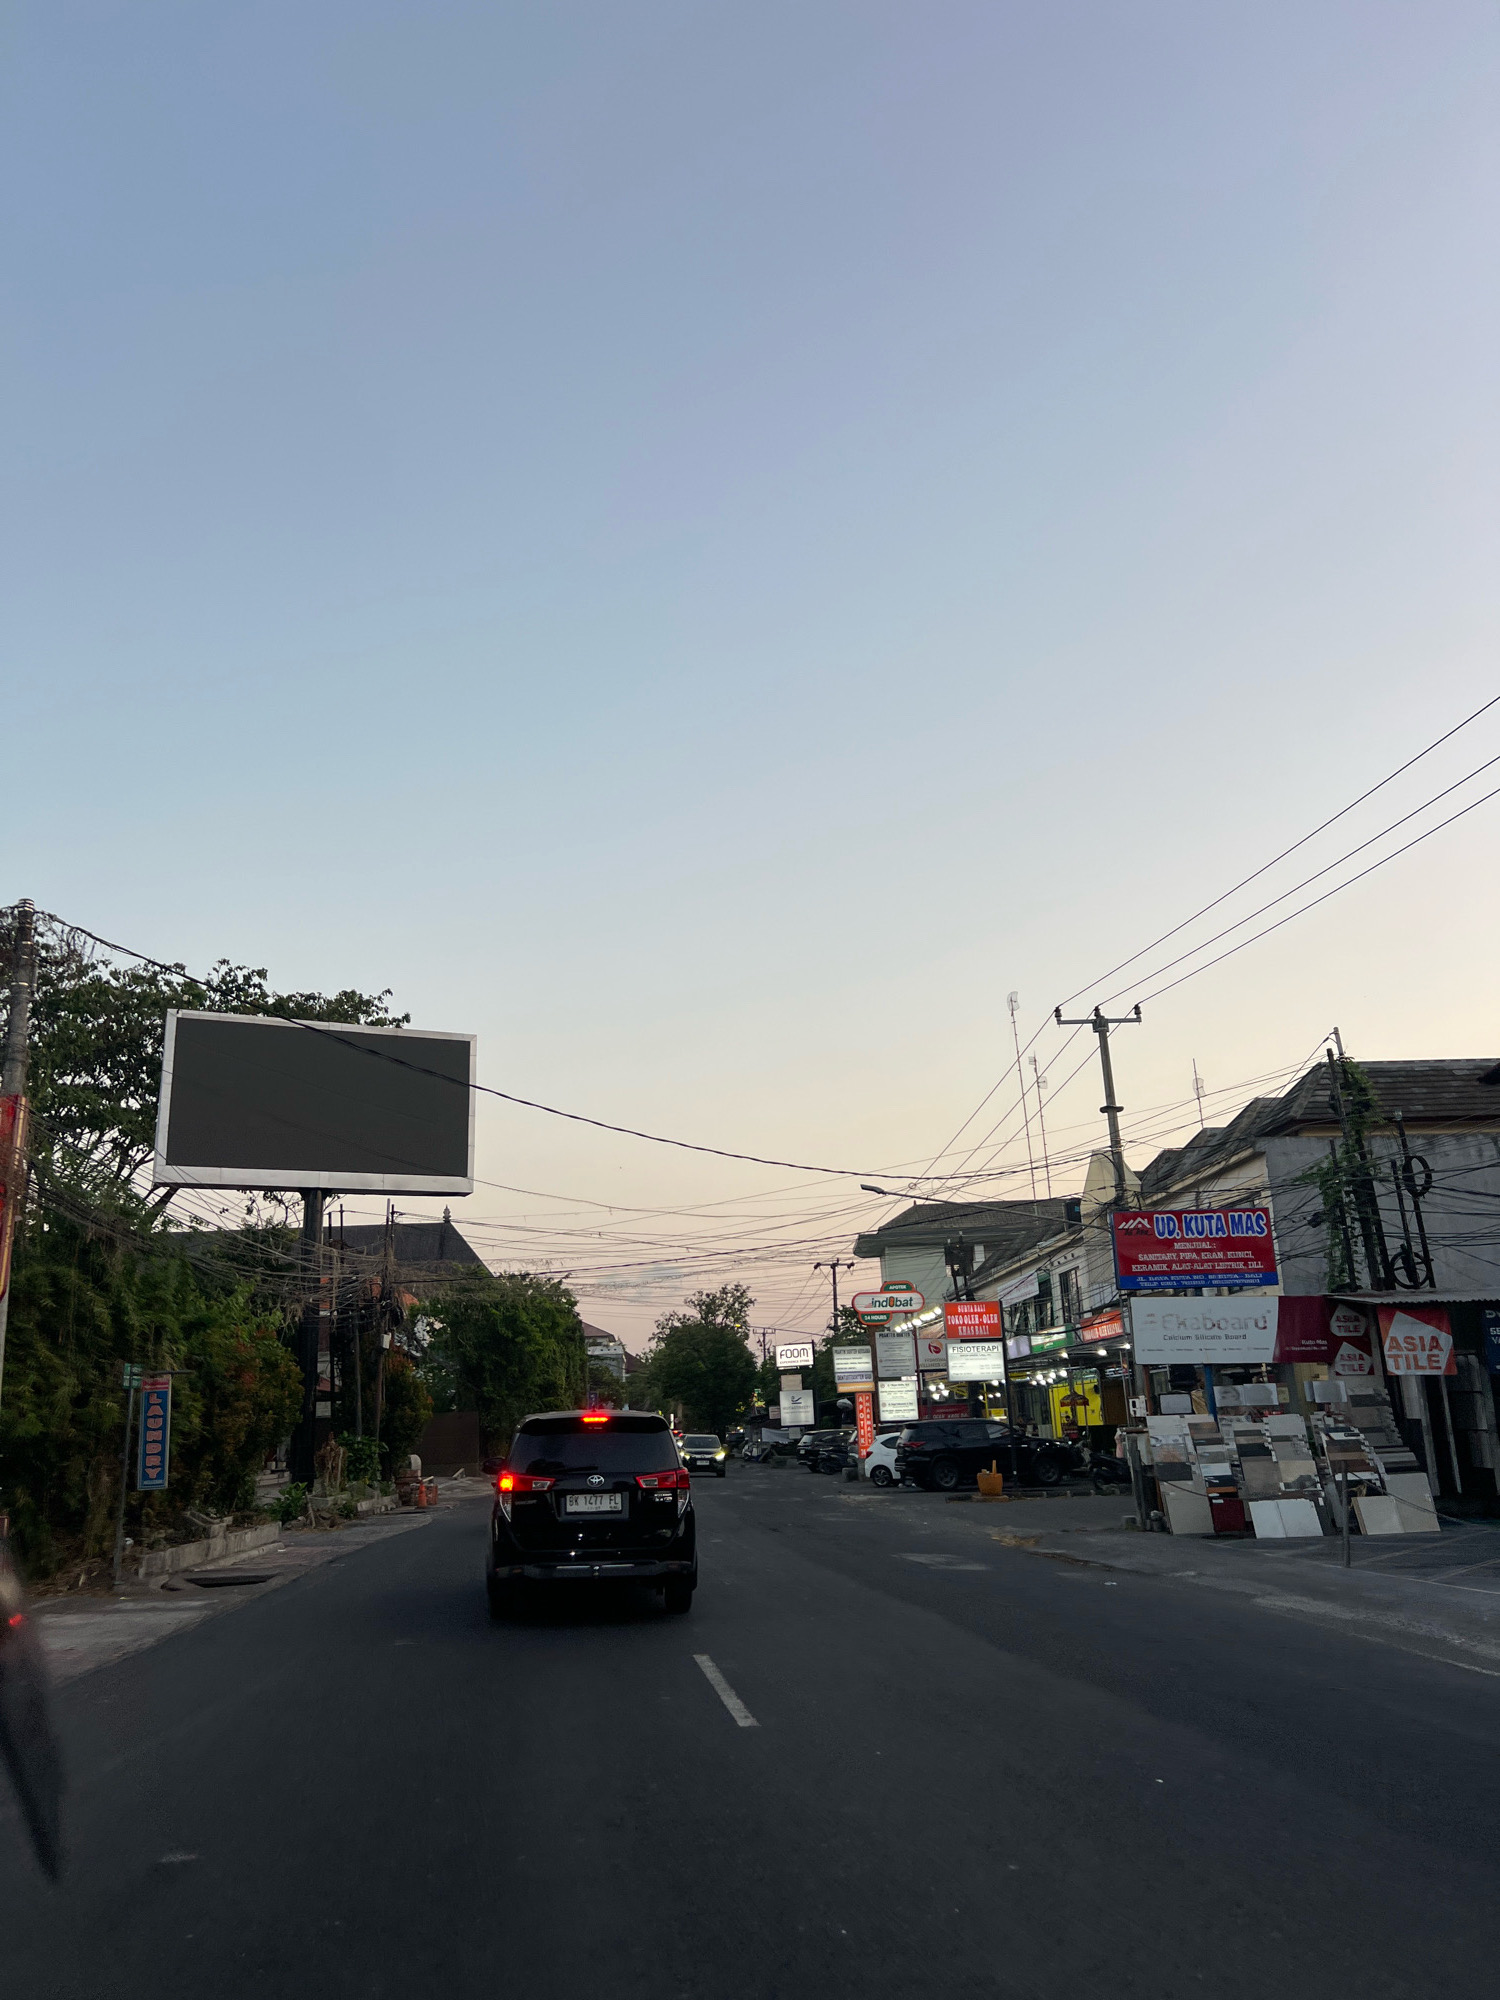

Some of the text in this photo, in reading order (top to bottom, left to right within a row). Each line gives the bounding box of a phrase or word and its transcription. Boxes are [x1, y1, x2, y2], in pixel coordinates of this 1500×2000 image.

[1154, 1211, 1268, 1239] UD. KUTA MAS
[974, 1304, 986, 1312] BALI
[947, 1315, 964, 1325] TOKO
[1335, 1315, 1361, 1323] ASIA
[958, 1325, 989, 1336] KHAS BALI
[1337, 1325, 1361, 1333] TILE
[1163, 1333, 1193, 1341] Calcium
[1224, 1333, 1247, 1341] Board
[952, 1345, 999, 1353] FISIOTERAPI
[1387, 1335, 1444, 1352] ASIA
[780, 1347, 808, 1359] FOOM
[1388, 1353, 1442, 1370] TILE
[145, 1393, 164, 1479] LAUNDRY
[584, 1495, 604, 1505] 1477
[609, 1494, 619, 1504] FL
